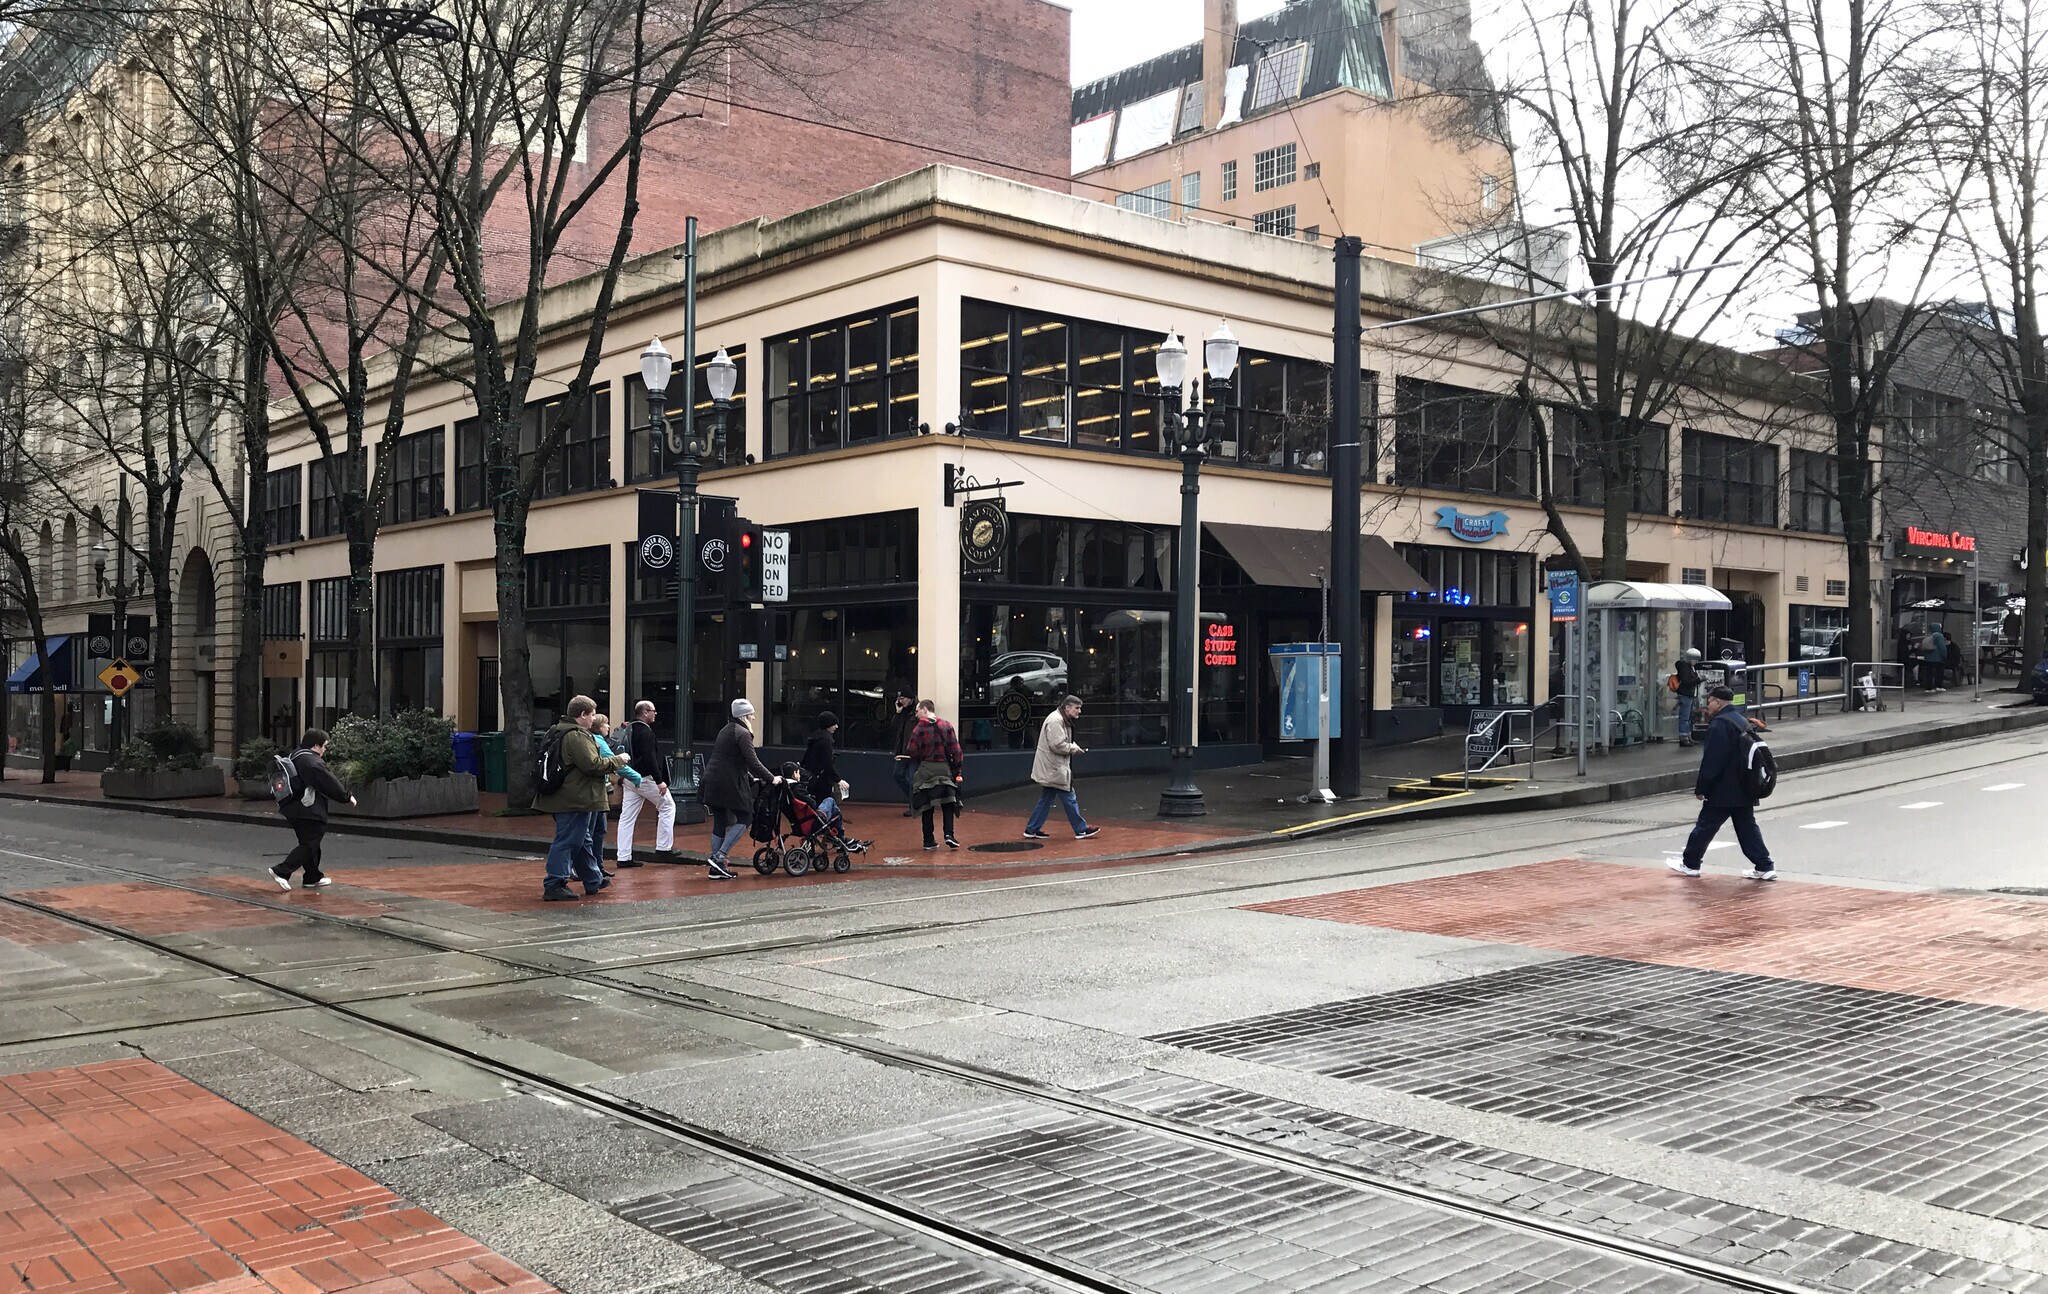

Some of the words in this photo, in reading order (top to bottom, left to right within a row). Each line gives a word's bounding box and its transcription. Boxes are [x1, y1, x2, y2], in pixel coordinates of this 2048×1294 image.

[982, 507, 1002, 528] STUDY
[1464, 518, 1490, 527] CRAFTY
[1454, 515, 1495, 537] Wonderland
[763, 535, 783, 549] NO
[1908, 526, 1951, 548] VIRGINIA
[1952, 531, 1975, 551] CAFE
[644, 537, 657, 556] PIONEER
[968, 546, 996, 559] COFFEE
[763, 553, 786, 565] URN
[765, 569, 780, 580] ON
[763, 585, 783, 596] RED
[1208, 623, 1233, 637] CASE
[1205, 638, 1237, 652] STUDY
[1205, 653, 1237, 665] COFFEE
